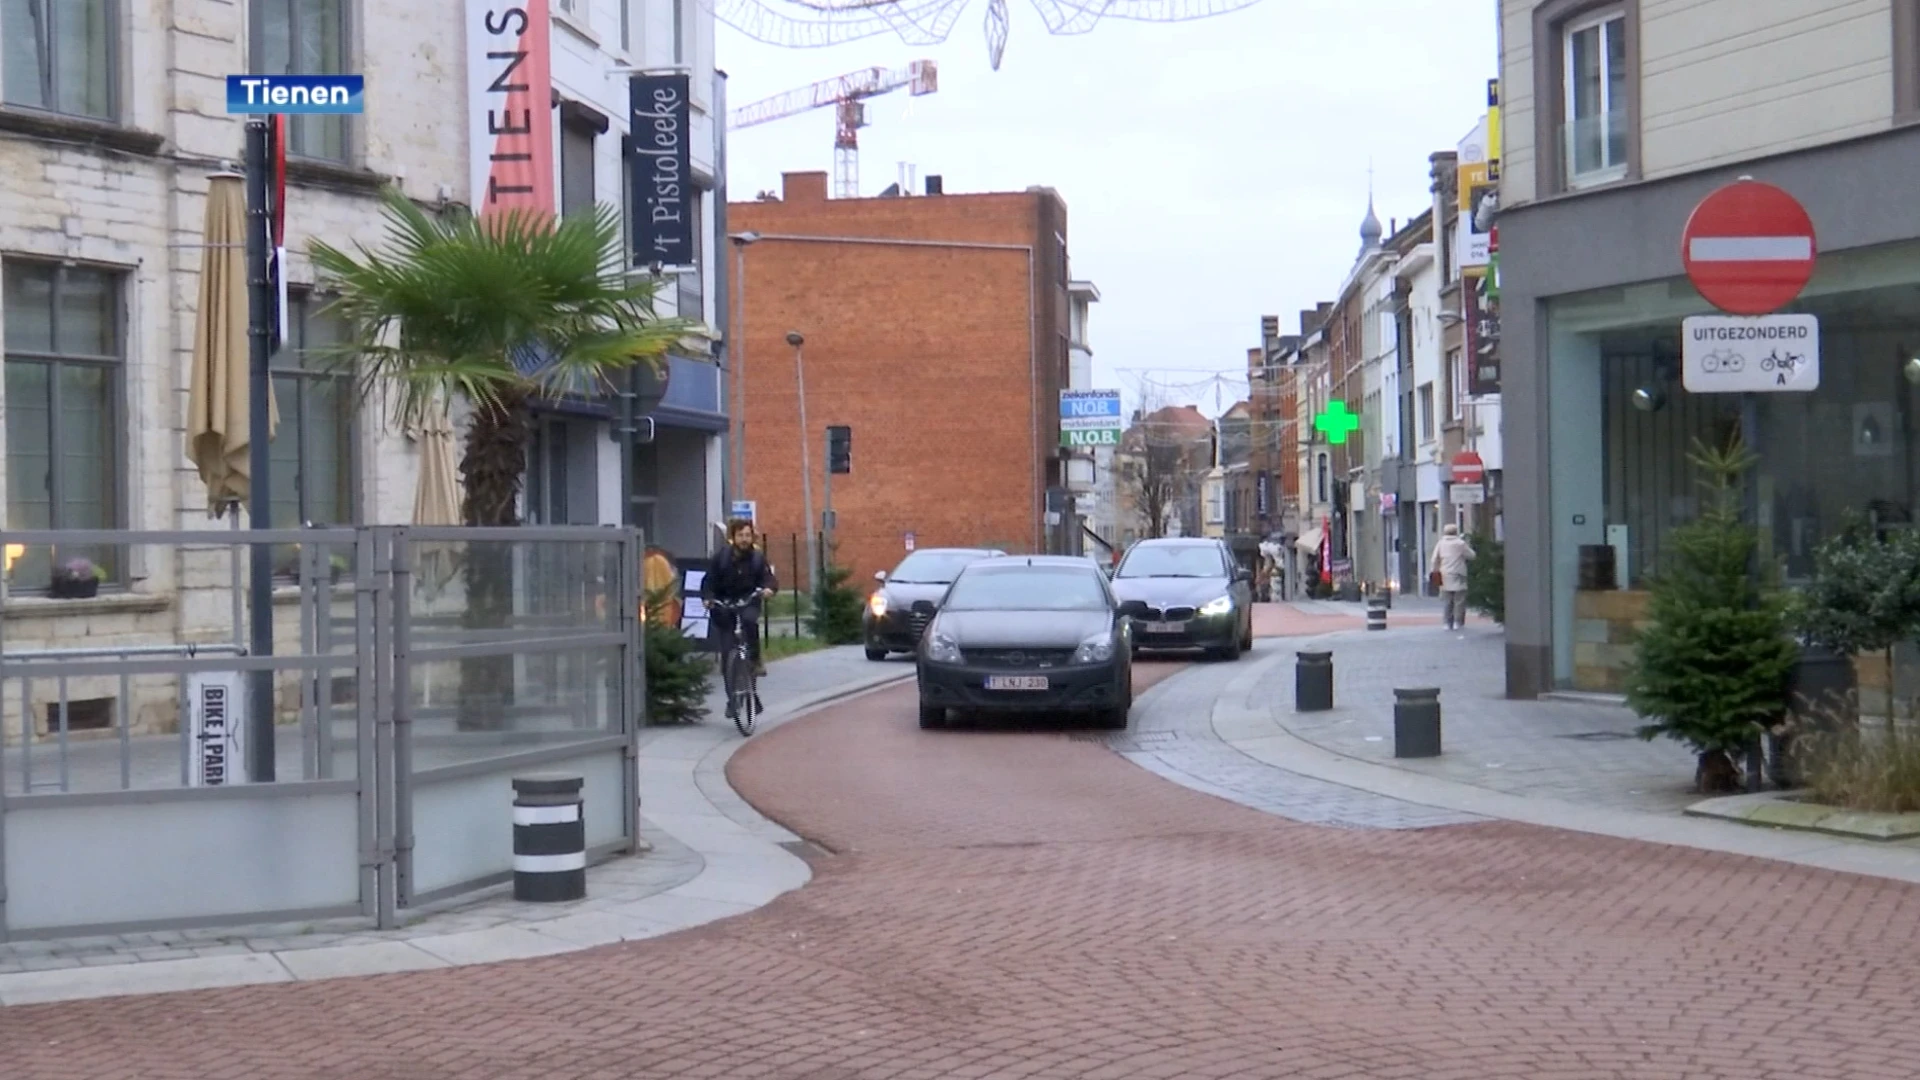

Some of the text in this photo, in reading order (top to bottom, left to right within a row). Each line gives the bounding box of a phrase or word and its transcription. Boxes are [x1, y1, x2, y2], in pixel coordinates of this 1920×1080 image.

[485, 7, 533, 203] TIENS
[635, 87, 682, 223] Pistoleeke
[1693, 326, 1808, 340] UITGEZONDERD
[1776, 373, 1786, 385] A
[1070, 431, 1117, 445] N.O.B.
[205, 689, 224, 728] BIKE
